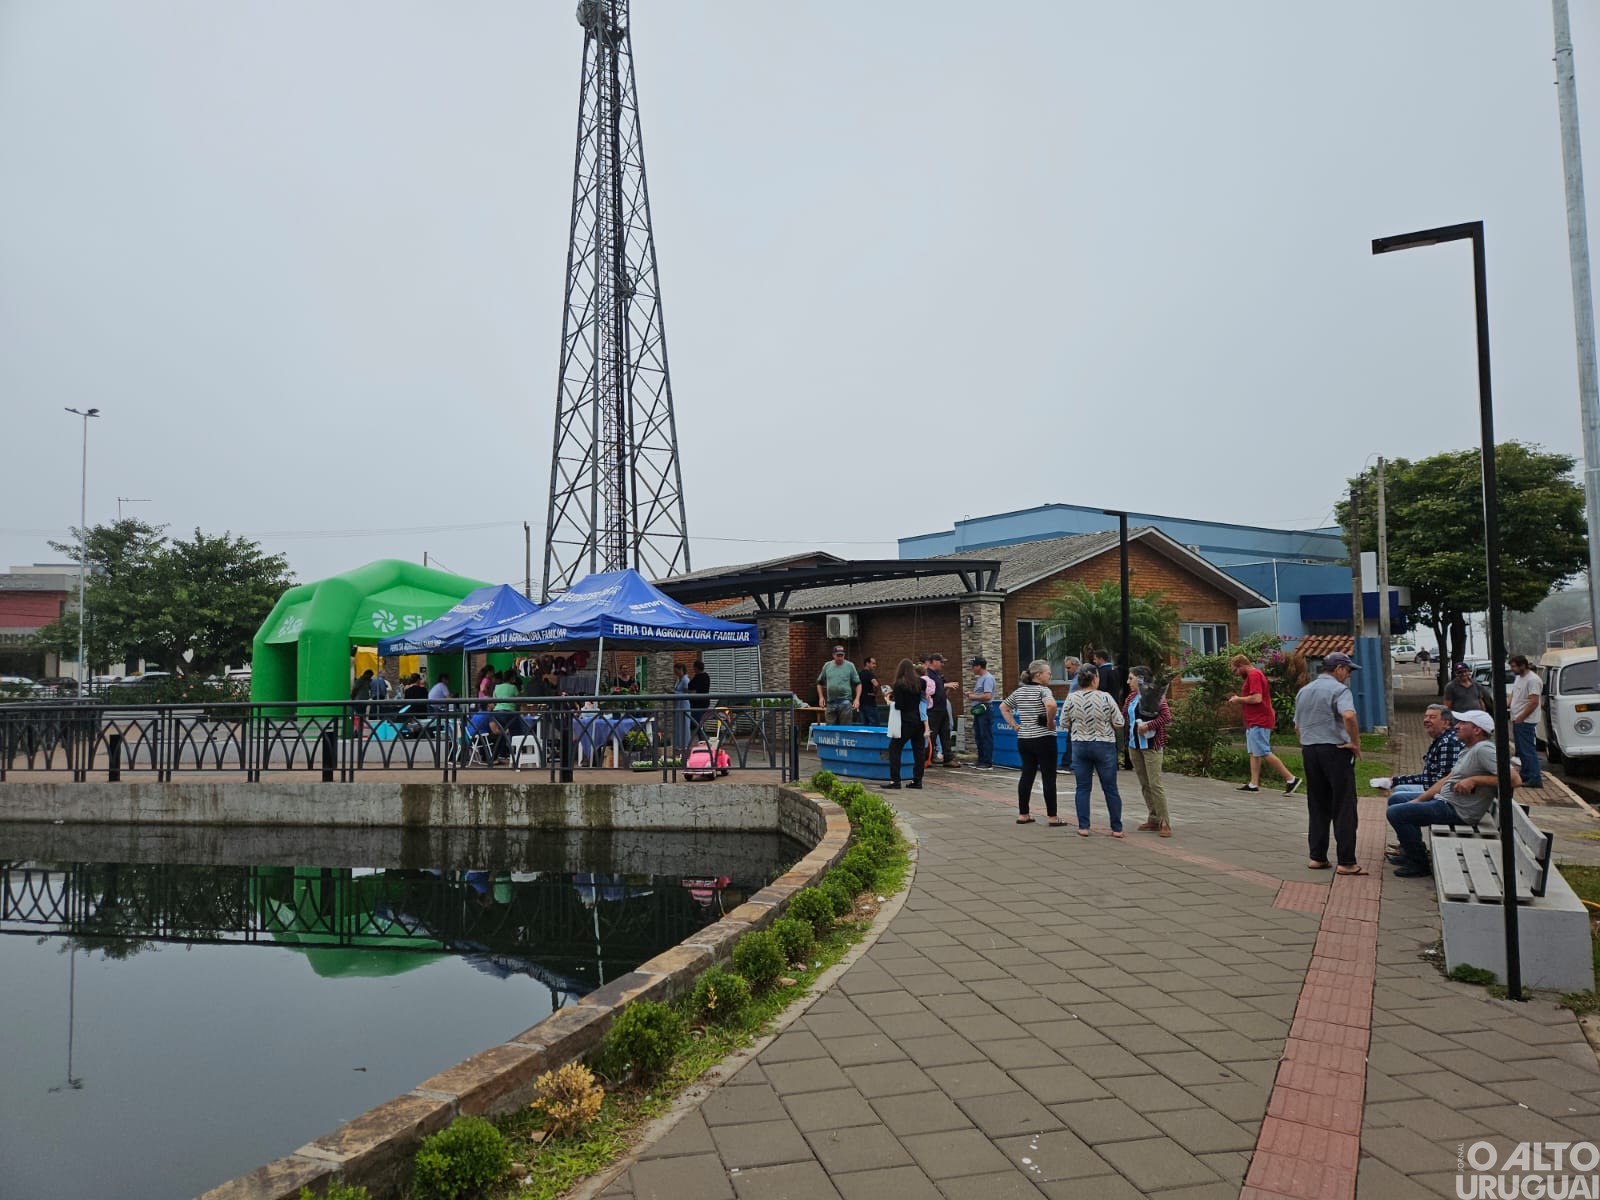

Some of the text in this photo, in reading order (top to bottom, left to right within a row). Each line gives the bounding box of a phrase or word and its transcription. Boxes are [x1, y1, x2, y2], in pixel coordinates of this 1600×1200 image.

[613, 623, 750, 642] FEIRA DA AGRICULTURA FAMILIAR
